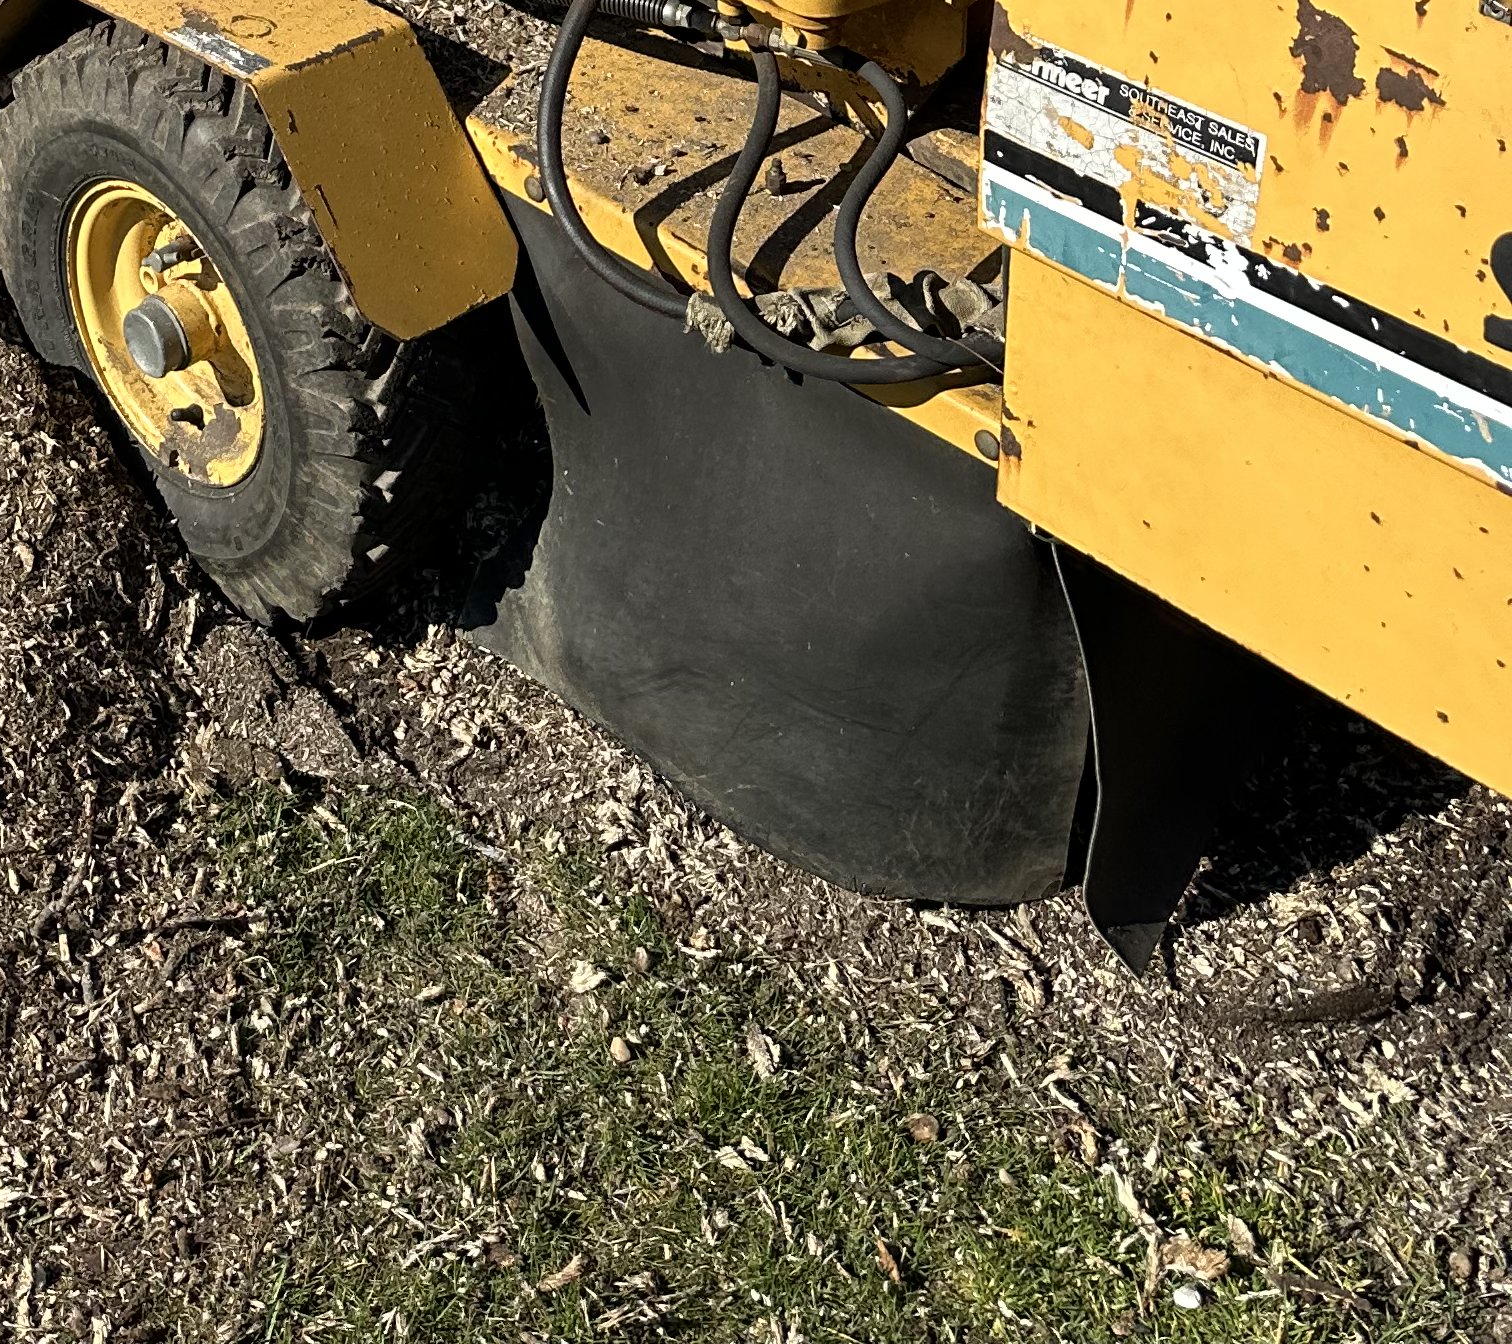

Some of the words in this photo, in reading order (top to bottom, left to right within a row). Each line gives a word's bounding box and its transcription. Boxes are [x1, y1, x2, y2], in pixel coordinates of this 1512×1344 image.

[1020, 55, 1110, 106] rmeer
[1119, 83, 1205, 131] SOUTHEAST
[1208, 121, 1256, 154] SALES
